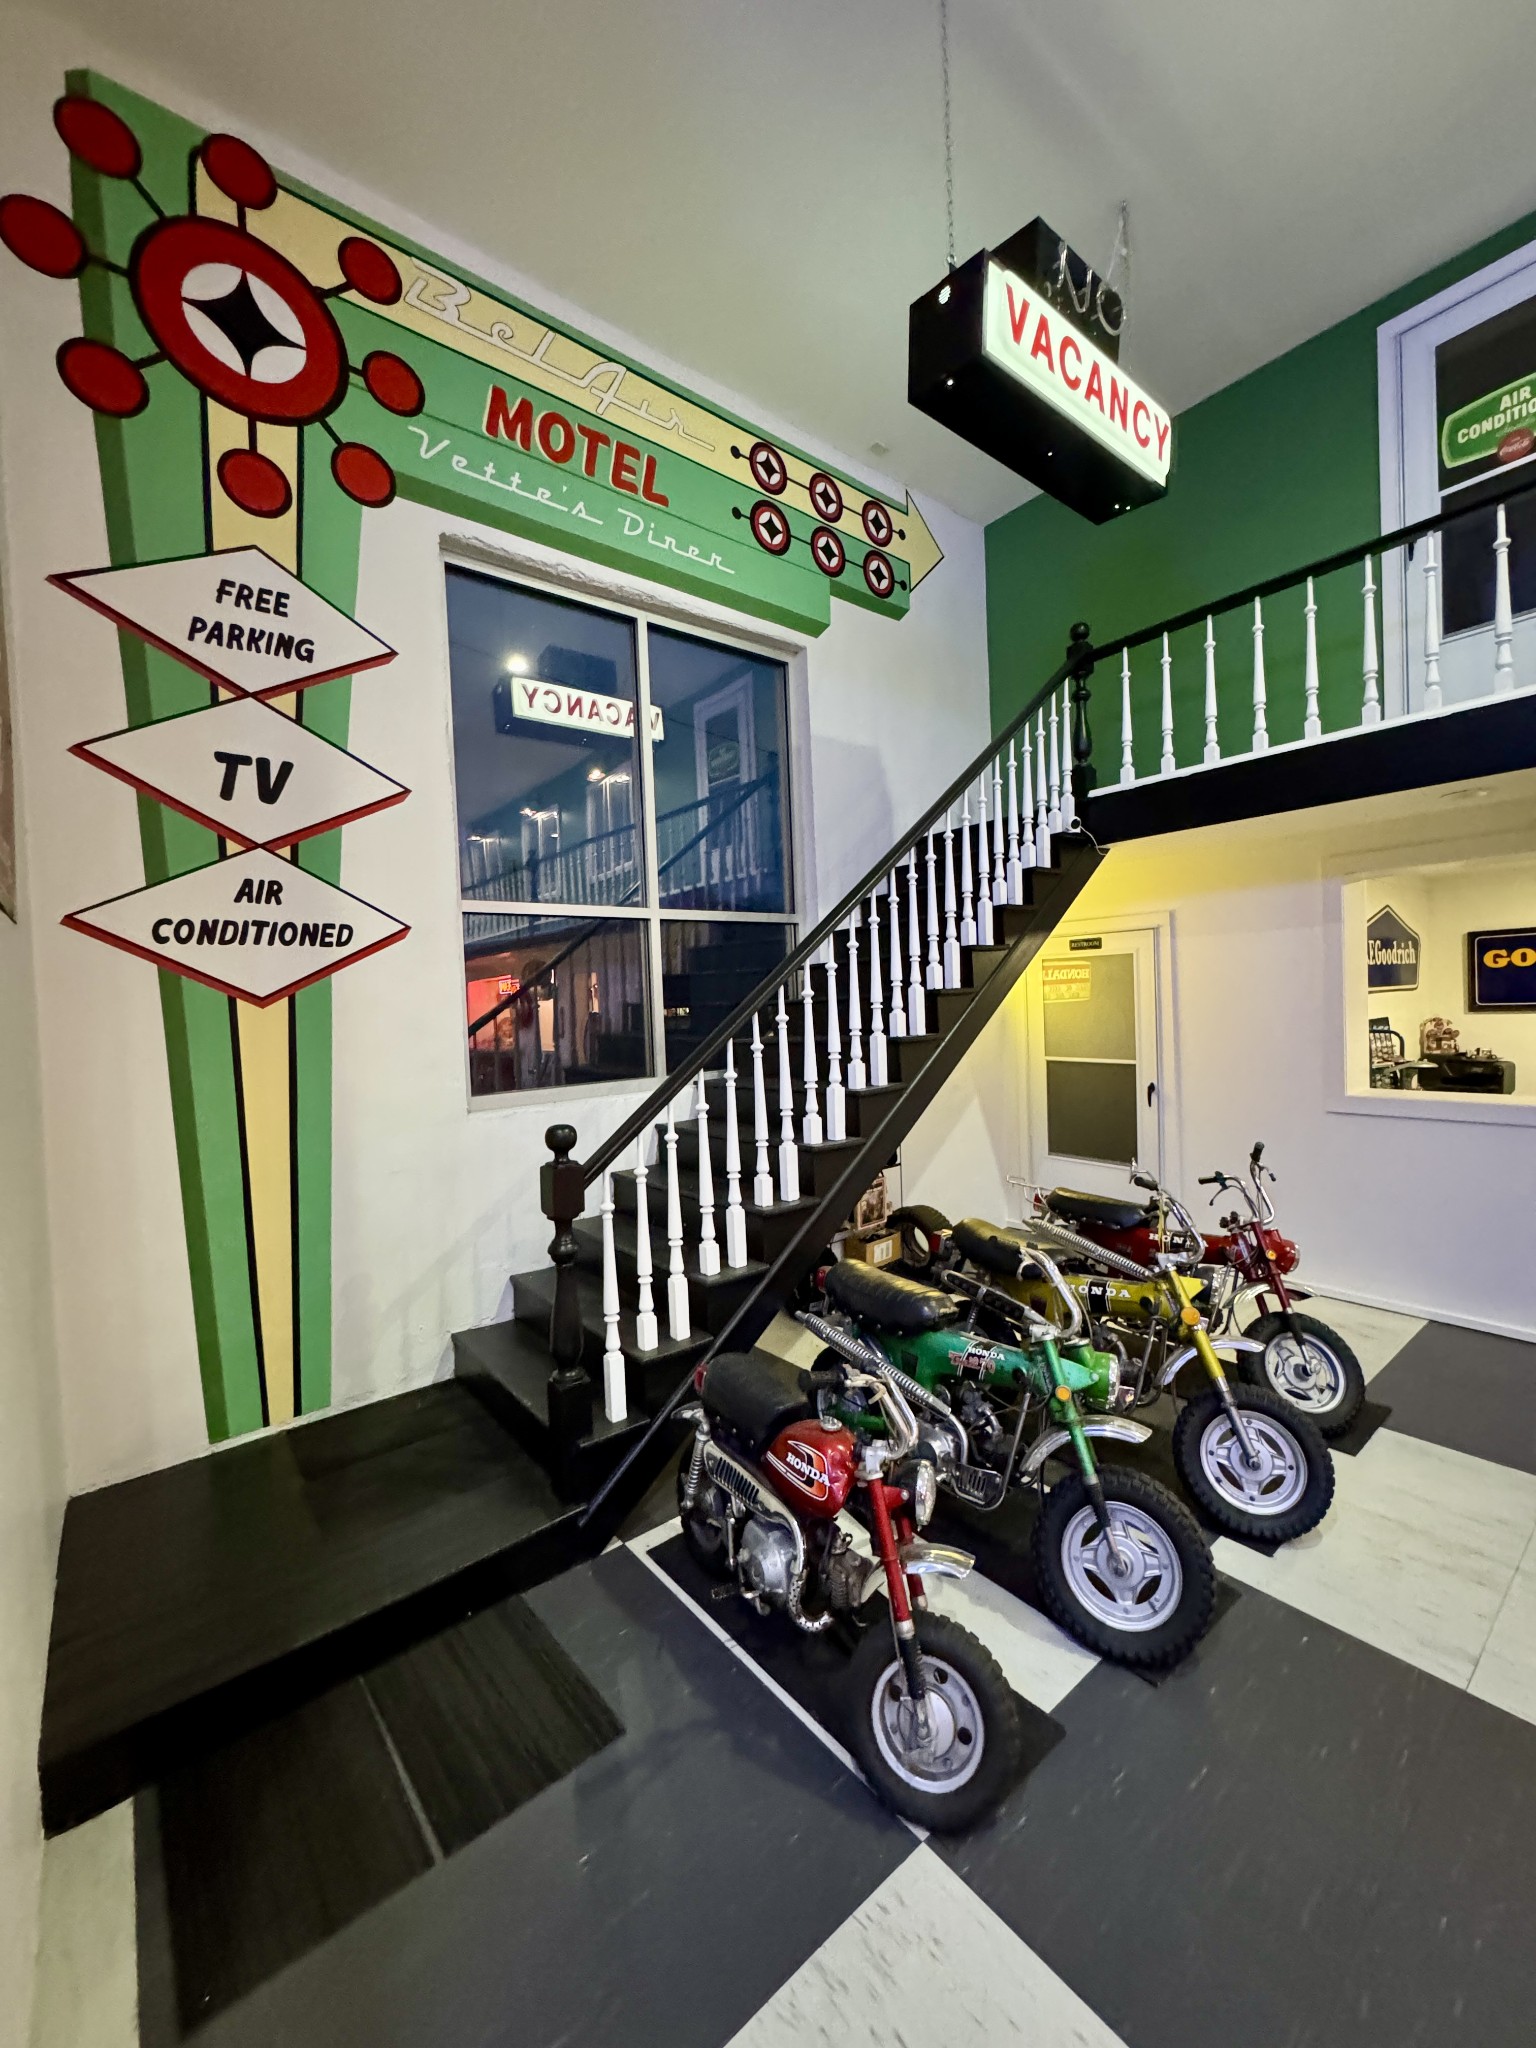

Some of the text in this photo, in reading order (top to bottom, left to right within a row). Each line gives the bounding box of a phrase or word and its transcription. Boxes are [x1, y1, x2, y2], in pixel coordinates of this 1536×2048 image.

[1005, 282, 1170, 462] VACANCY
[1499, 385, 1532, 412] AIR
[482, 384, 669, 508] MOTEL
[408, 425, 735, 574] Vette's Diner
[215, 578, 290, 618] FREE
[187, 615, 315, 663] PARKING
[214, 750, 294, 805] TV
[233, 878, 284, 906] AIR
[151, 917, 354, 948] CONDITIONED
[968, 1346, 1006, 1361] HONDA
[786, 1451, 831, 1487] HONDA
